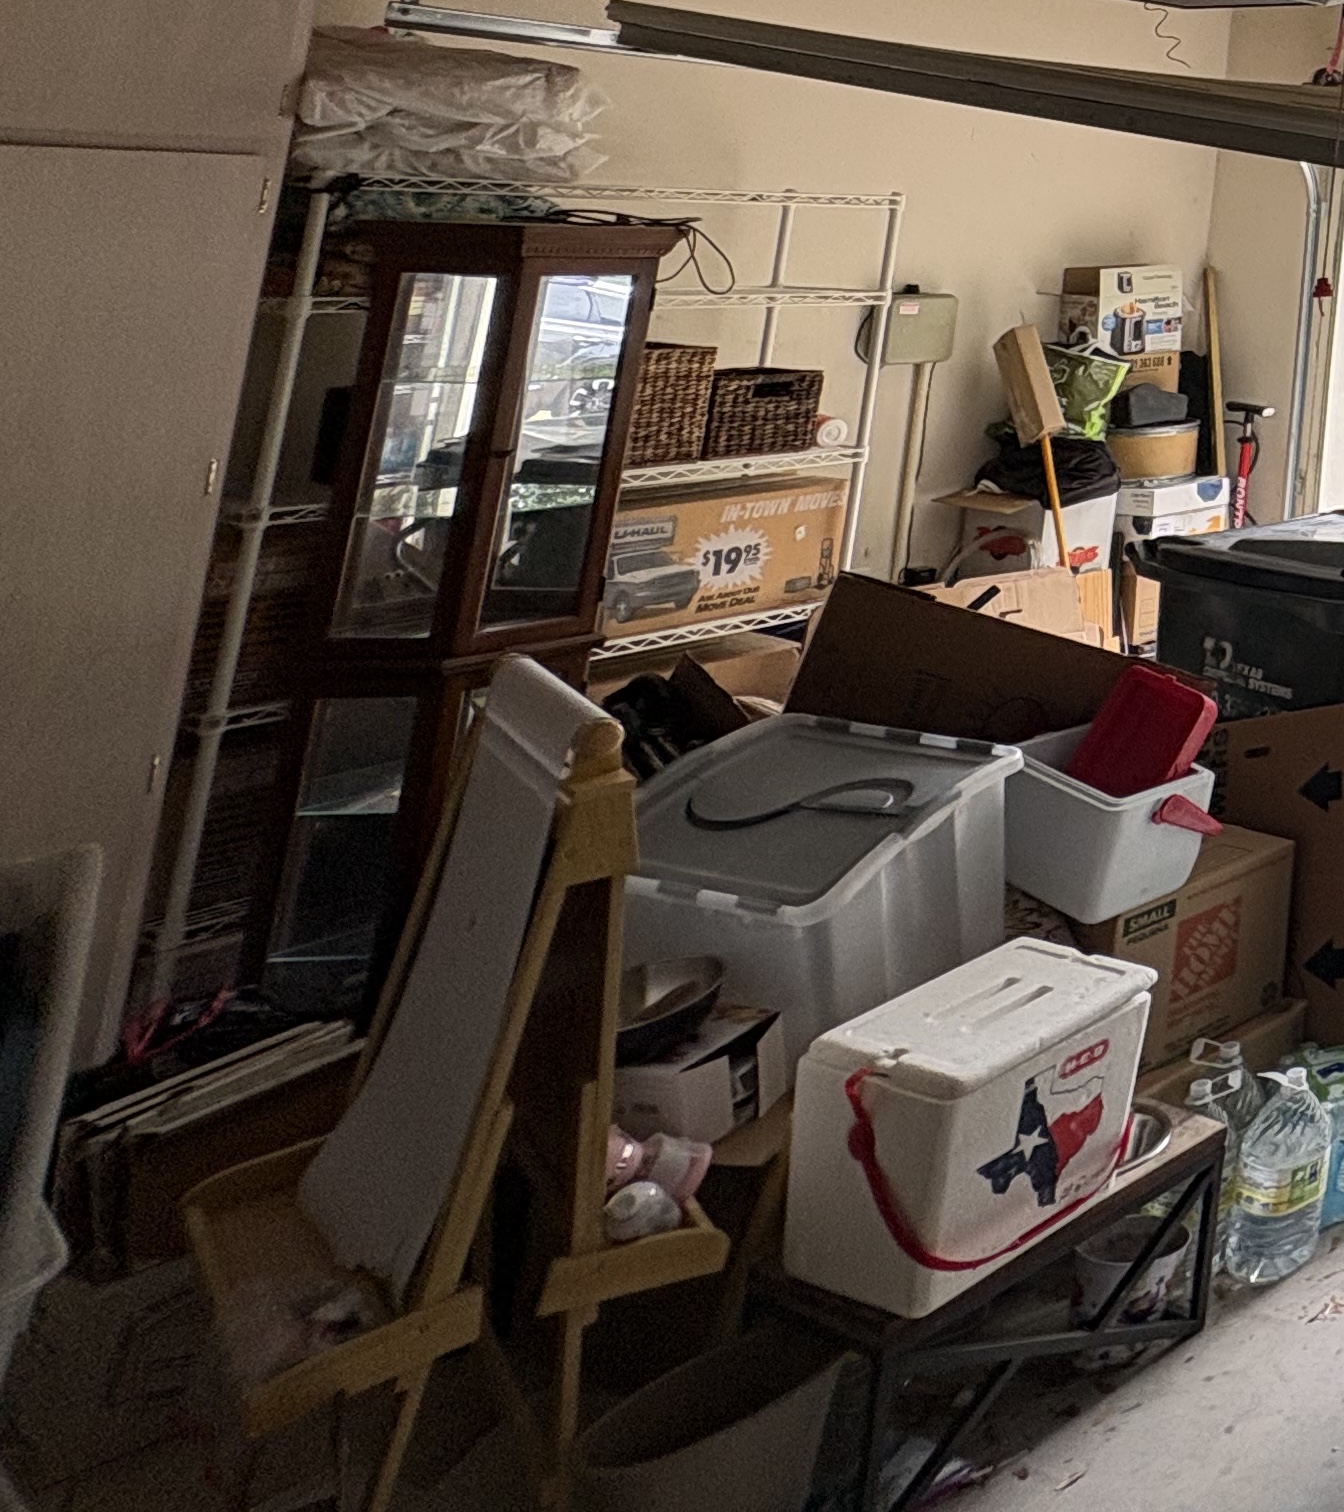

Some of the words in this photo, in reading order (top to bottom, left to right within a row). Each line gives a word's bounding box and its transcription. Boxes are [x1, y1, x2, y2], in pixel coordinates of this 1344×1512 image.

[1154, 301, 1179, 309] Beach
[720, 498, 790, 523] IN-TOWN
[794, 491, 847, 513] MOVES
[614, 526, 668, 540] U-HAUL
[1129, 904, 1171, 931] SMALL
